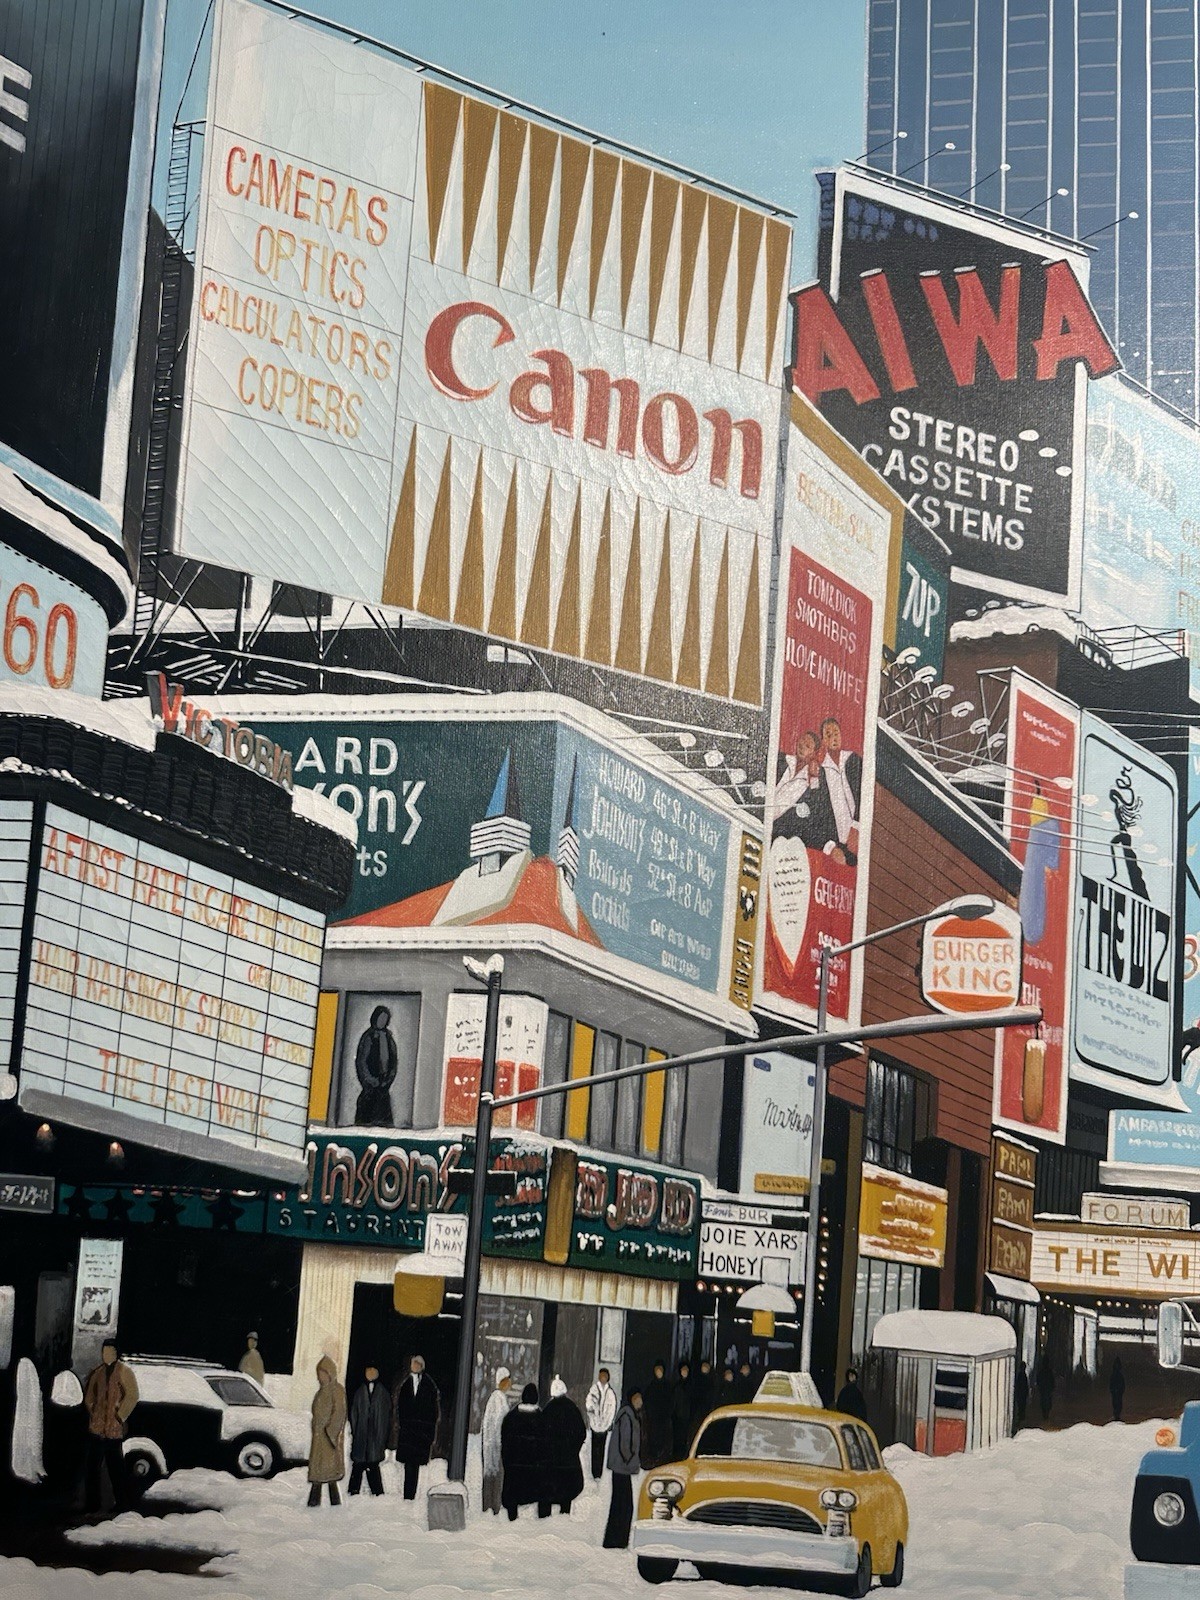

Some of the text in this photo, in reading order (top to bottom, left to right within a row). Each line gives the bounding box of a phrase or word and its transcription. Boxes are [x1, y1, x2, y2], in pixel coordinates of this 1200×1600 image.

[225, 145, 390, 247] CAMERAS
[254, 224, 368, 310] OPTICS
[200, 280, 392, 381] CALCULATORS
[786, 258, 1121, 405] AIWA
[238, 356, 364, 439] COPIERS
[424, 301, 764, 499] Canon
[888, 406, 1020, 473] STEREO
[860, 443, 1034, 515] CASSETTE
[2, 582, 79, 690] 60
[901, 561, 942, 638] 7UP
[150, 671, 294, 792] VICTORIA
[294, 736, 400, 776] ARD
[598, 751, 646, 804] HOWARD
[44, 827, 60, 874] A
[63, 832, 127, 895] FIRST
[132, 859, 188, 917] RATE
[191, 882, 253, 940] SCARE
[933, 940, 1014, 965] BURGER
[1081, 875, 1172, 1004] THE WIZ
[931, 965, 1013, 993] KING
[98, 1046, 275, 1139] THE LAST WAVE
[433, 1239, 464, 1251] AWAY
[436, 1222, 464, 1236] TOW
[701, 1226, 747, 1247] JOIE
[753, 1229, 798, 1251] XARS
[1088, 1201, 1186, 1227] FORUM
[700, 1250, 758, 1276] HONEY
[1048, 1245, 1121, 1277] THE
